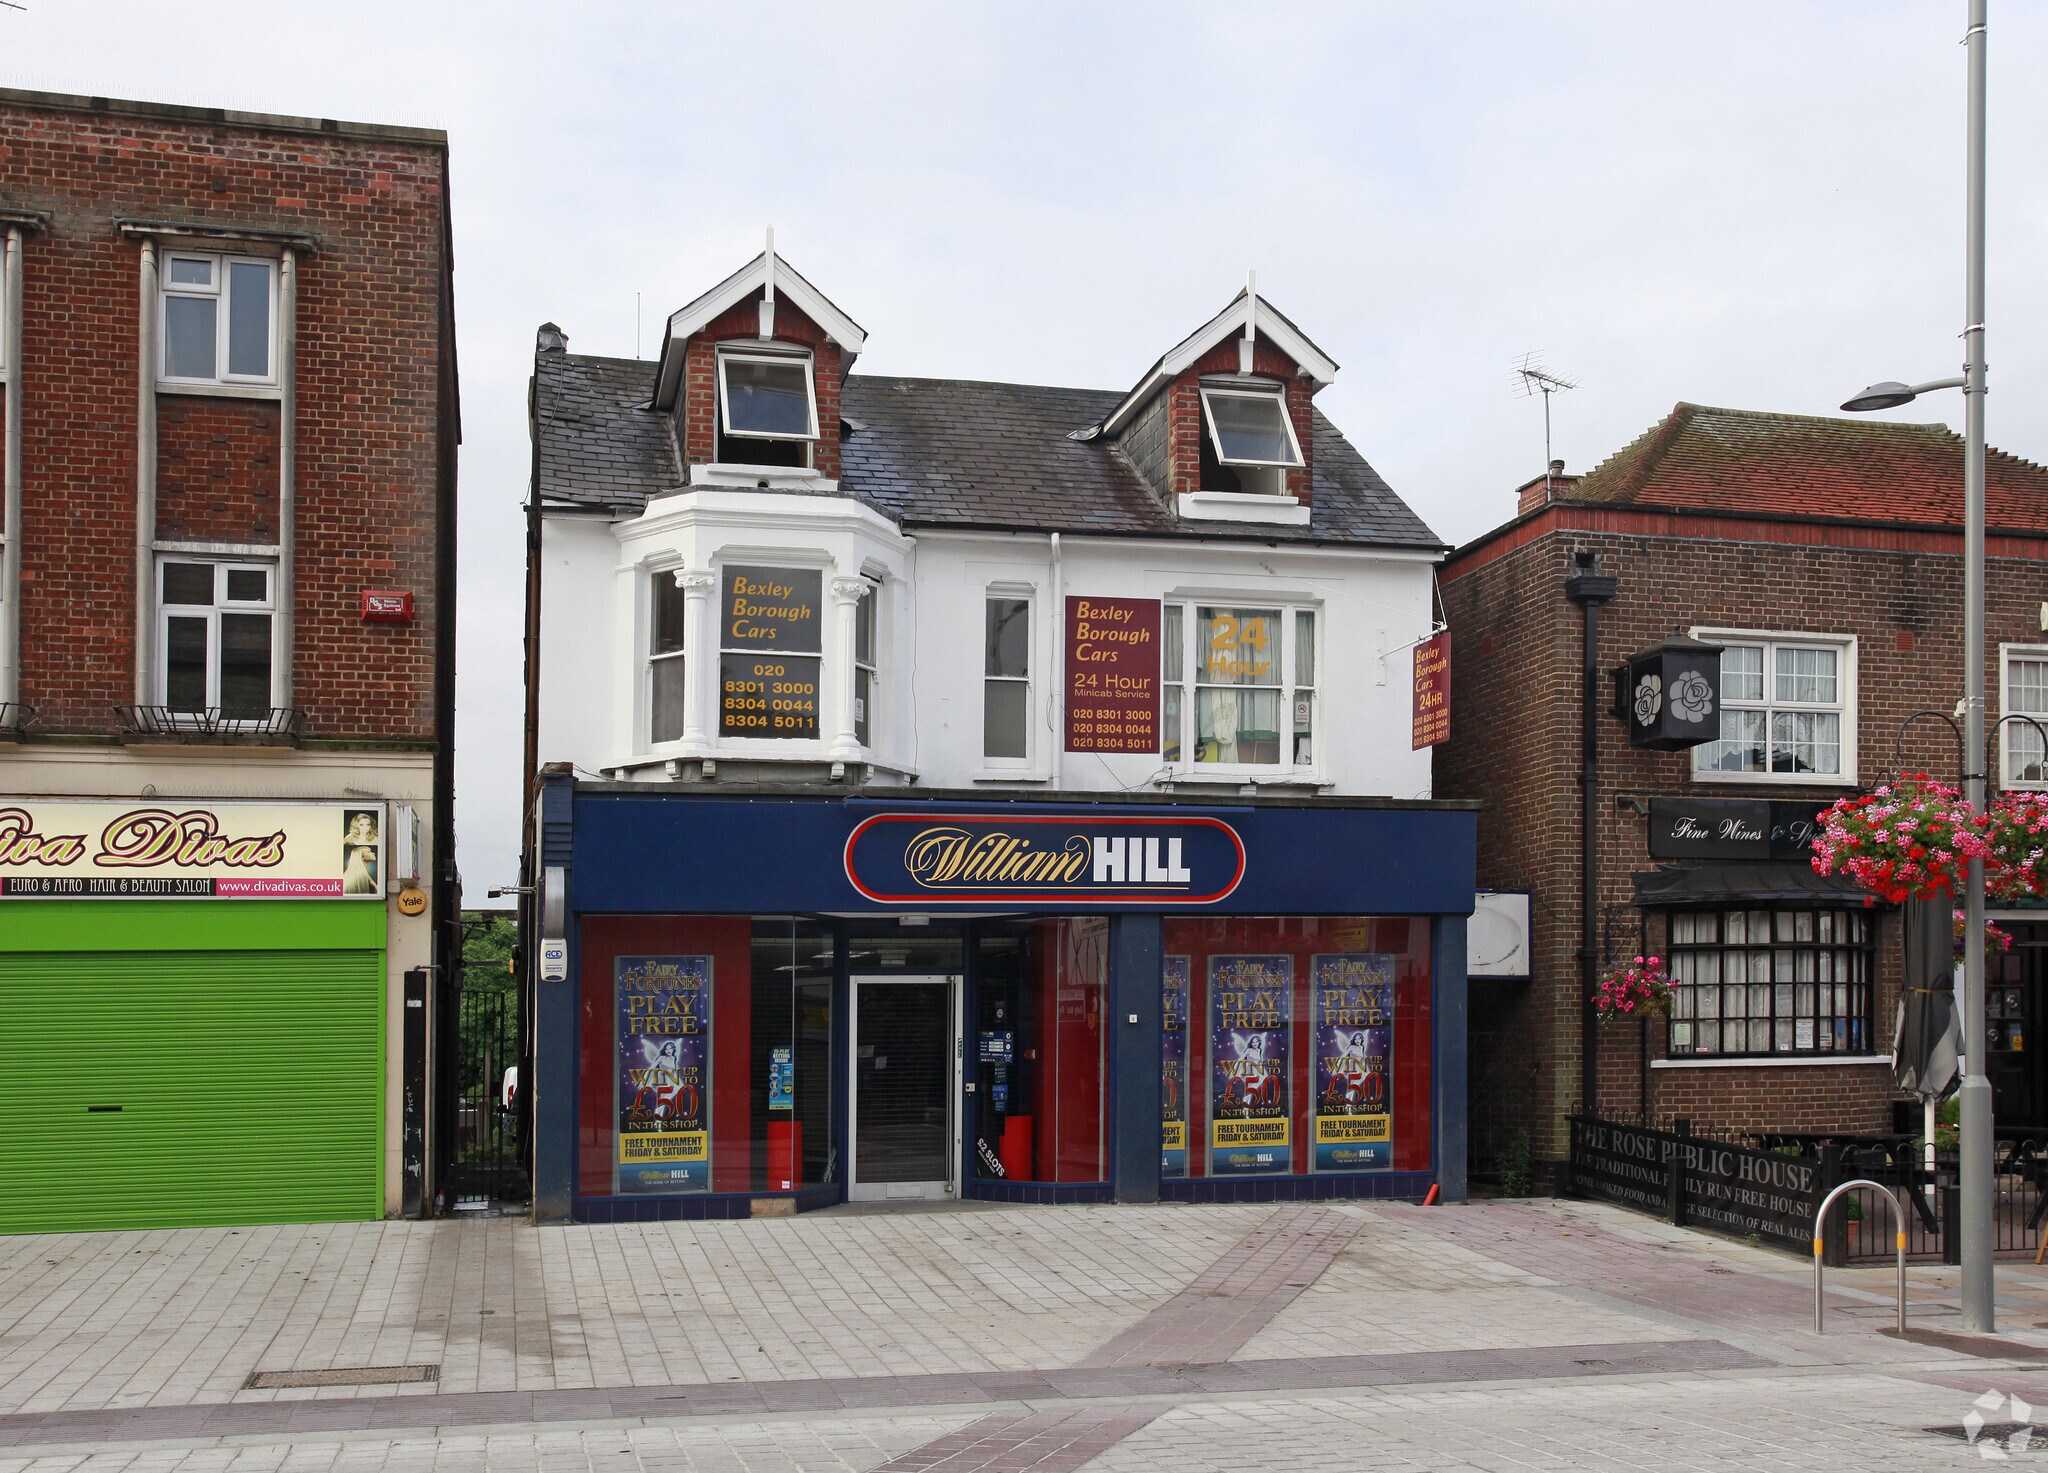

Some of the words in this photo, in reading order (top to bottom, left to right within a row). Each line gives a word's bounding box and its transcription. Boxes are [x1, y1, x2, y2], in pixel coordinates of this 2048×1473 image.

[733, 576, 794, 599] Bexley
[732, 598, 811, 622] Borough
[1077, 601, 1134, 624] Bexley
[732, 619, 777, 639] Cars
[1076, 622, 1150, 645] Borough
[1211, 615, 1269, 651] 24
[1076, 643, 1119, 662] Cars
[1416, 647, 1440, 664] Bexley
[753, 664, 785, 677] 020
[1208, 655, 1271, 676] Hour
[1416, 657, 1447, 679] Borough
[725, 681, 765, 693] 8301
[772, 682, 814, 695] 3000
[1074, 673, 1098, 688] 24
[1105, 674, 1151, 689] Hour
[1415, 678, 1434, 693] Cars
[1074, 689, 1113, 698] Minicab
[1115, 690, 1151, 699] Service
[1420, 692, 1443, 711] 24HR
[725, 698, 767, 710] 8304
[772, 699, 814, 711] 0044
[725, 715, 768, 727] 8304
[774, 716, 814, 728] 5011
[1073, 709, 1093, 719] 020
[1096, 709, 1121, 720] 8301
[1125, 710, 1152, 721] 3000
[1413, 716, 1423, 726] 020
[1435, 708, 1448, 719] 3000
[1073, 723, 1093, 733] 020
[1096, 723, 1122, 734] 8304
[1125, 724, 1152, 735] 0044
[1413, 727, 1423, 737] 020
[1436, 729, 1448, 739] 5011
[1073, 737, 1093, 747] 020
[1096, 738, 1123, 748] 8304
[1127, 738, 1152, 749] 5011
[1670, 816, 1709, 840] Fine
[1718, 818, 1762, 841] Wines
[1770, 825, 1786, 840] &
[93, 808, 287, 867] Divas
[904, 826, 1091, 884] William
[1093, 836, 1191, 883] HILL
[11, 878, 39, 892] EURO
[42, 878, 51, 892] &
[54, 878, 83, 892] AFRO
[90, 878, 117, 892] HAIR
[120, 879, 128, 892] &
[131, 878, 173, 893] BEAUTY
[175, 878, 210, 893] SALON
[219, 880, 341, 893] www.divadivas.co.uk
[403, 897, 423, 906] Yale
[646, 961, 679, 978] FAIRY
[1236, 960, 1265, 975] FAIRY
[1339, 958, 1367, 974] FAIRY
[625, 971, 701, 994] FORTUNES
[1218, 970, 1284, 991] FORTUNES
[1321, 967, 1386, 988] FORTUNES
[628, 995, 698, 1016] PLAY
[1220, 991, 1281, 1010] PLAY
[1323, 989, 1383, 1009] PLAY
[628, 1015, 699, 1036] FREE
[1220, 1011, 1281, 1029] FREE
[1324, 1008, 1383, 1027] FREE
[1267, 1058, 1281, 1066] UP
[1324, 1055, 1367, 1073] WIN
[1369, 1055, 1383, 1064] UP
[1369, 1063, 1383, 1072] TO
[682, 1066, 699, 1076] UP
[1220, 1059, 1265, 1077] WIN
[1267, 1067, 1281, 1075] TO
[628, 1067, 680, 1087] WIN
[682, 1076, 699, 1085] TO
[1220, 1075, 1281, 1108] £50
[1323, 1071, 1383, 1105] £50
[627, 1084, 699, 1121] £50
[1323, 1105, 1334, 1113] IN
[1359, 1103, 1383, 1112] SHOP
[1220, 1109, 1231, 1117] IN
[1255, 1107, 1281, 1115] SHOP
[628, 1121, 641, 1130] IN
[670, 1119, 698, 1129] SHOP
[1218, 1124, 1235, 1134] FREE
[1236, 1123, 1284, 1133] TOURNAMENT
[1320, 1120, 1337, 1129] FREE
[1338, 1119, 1386, 1129] TOURNAMENT
[1218, 1133, 1241, 1143] FRIDAY
[1242, 1132, 1249, 1142] &
[1249, 1131, 1285, 1142] SATURDAY
[1320, 1129, 1344, 1138] FRIDAY
[1344, 1128, 1351, 1138] &
[1352, 1128, 1386, 1137] SATURDAY
[625, 1138, 644, 1148] FREE
[646, 1136, 703, 1148] TOURNAMENT
[625, 1147, 652, 1158] FRIDAY
[653, 1147, 660, 1157] &
[662, 1146, 703, 1157] SATURDAY
[977, 1138, 987, 1153] £2
[985, 1149, 1005, 1177] SLOTS
[1257, 1153, 1273, 1162] HILL
[1359, 1149, 1375, 1158] HILL
[1575, 1122, 1608, 1150] THE
[1612, 1129, 1656, 1161] ROSE
[1738, 1154, 1813, 1193] HOUSE
[671, 1169, 690, 1179] HILL
[1595, 1156, 1661, 1185] TRADITIONAL
[1663, 1173, 1704, 1195] FILY
[1707, 1182, 1732, 1200] RUN
[1734, 1187, 1767, 1208] FREE
[1769, 1195, 1812, 1218] HOUSE
[1624, 1188, 1645, 1204] FOOD
[1645, 1194, 1660, 1206] AND
[1697, 1205, 1745, 1225] SELECTION
[1746, 1216, 1760, 1229] OF
[1761, 1220, 1787, 1236] REAL
[1788, 1228, 1811, 1242] ALES
